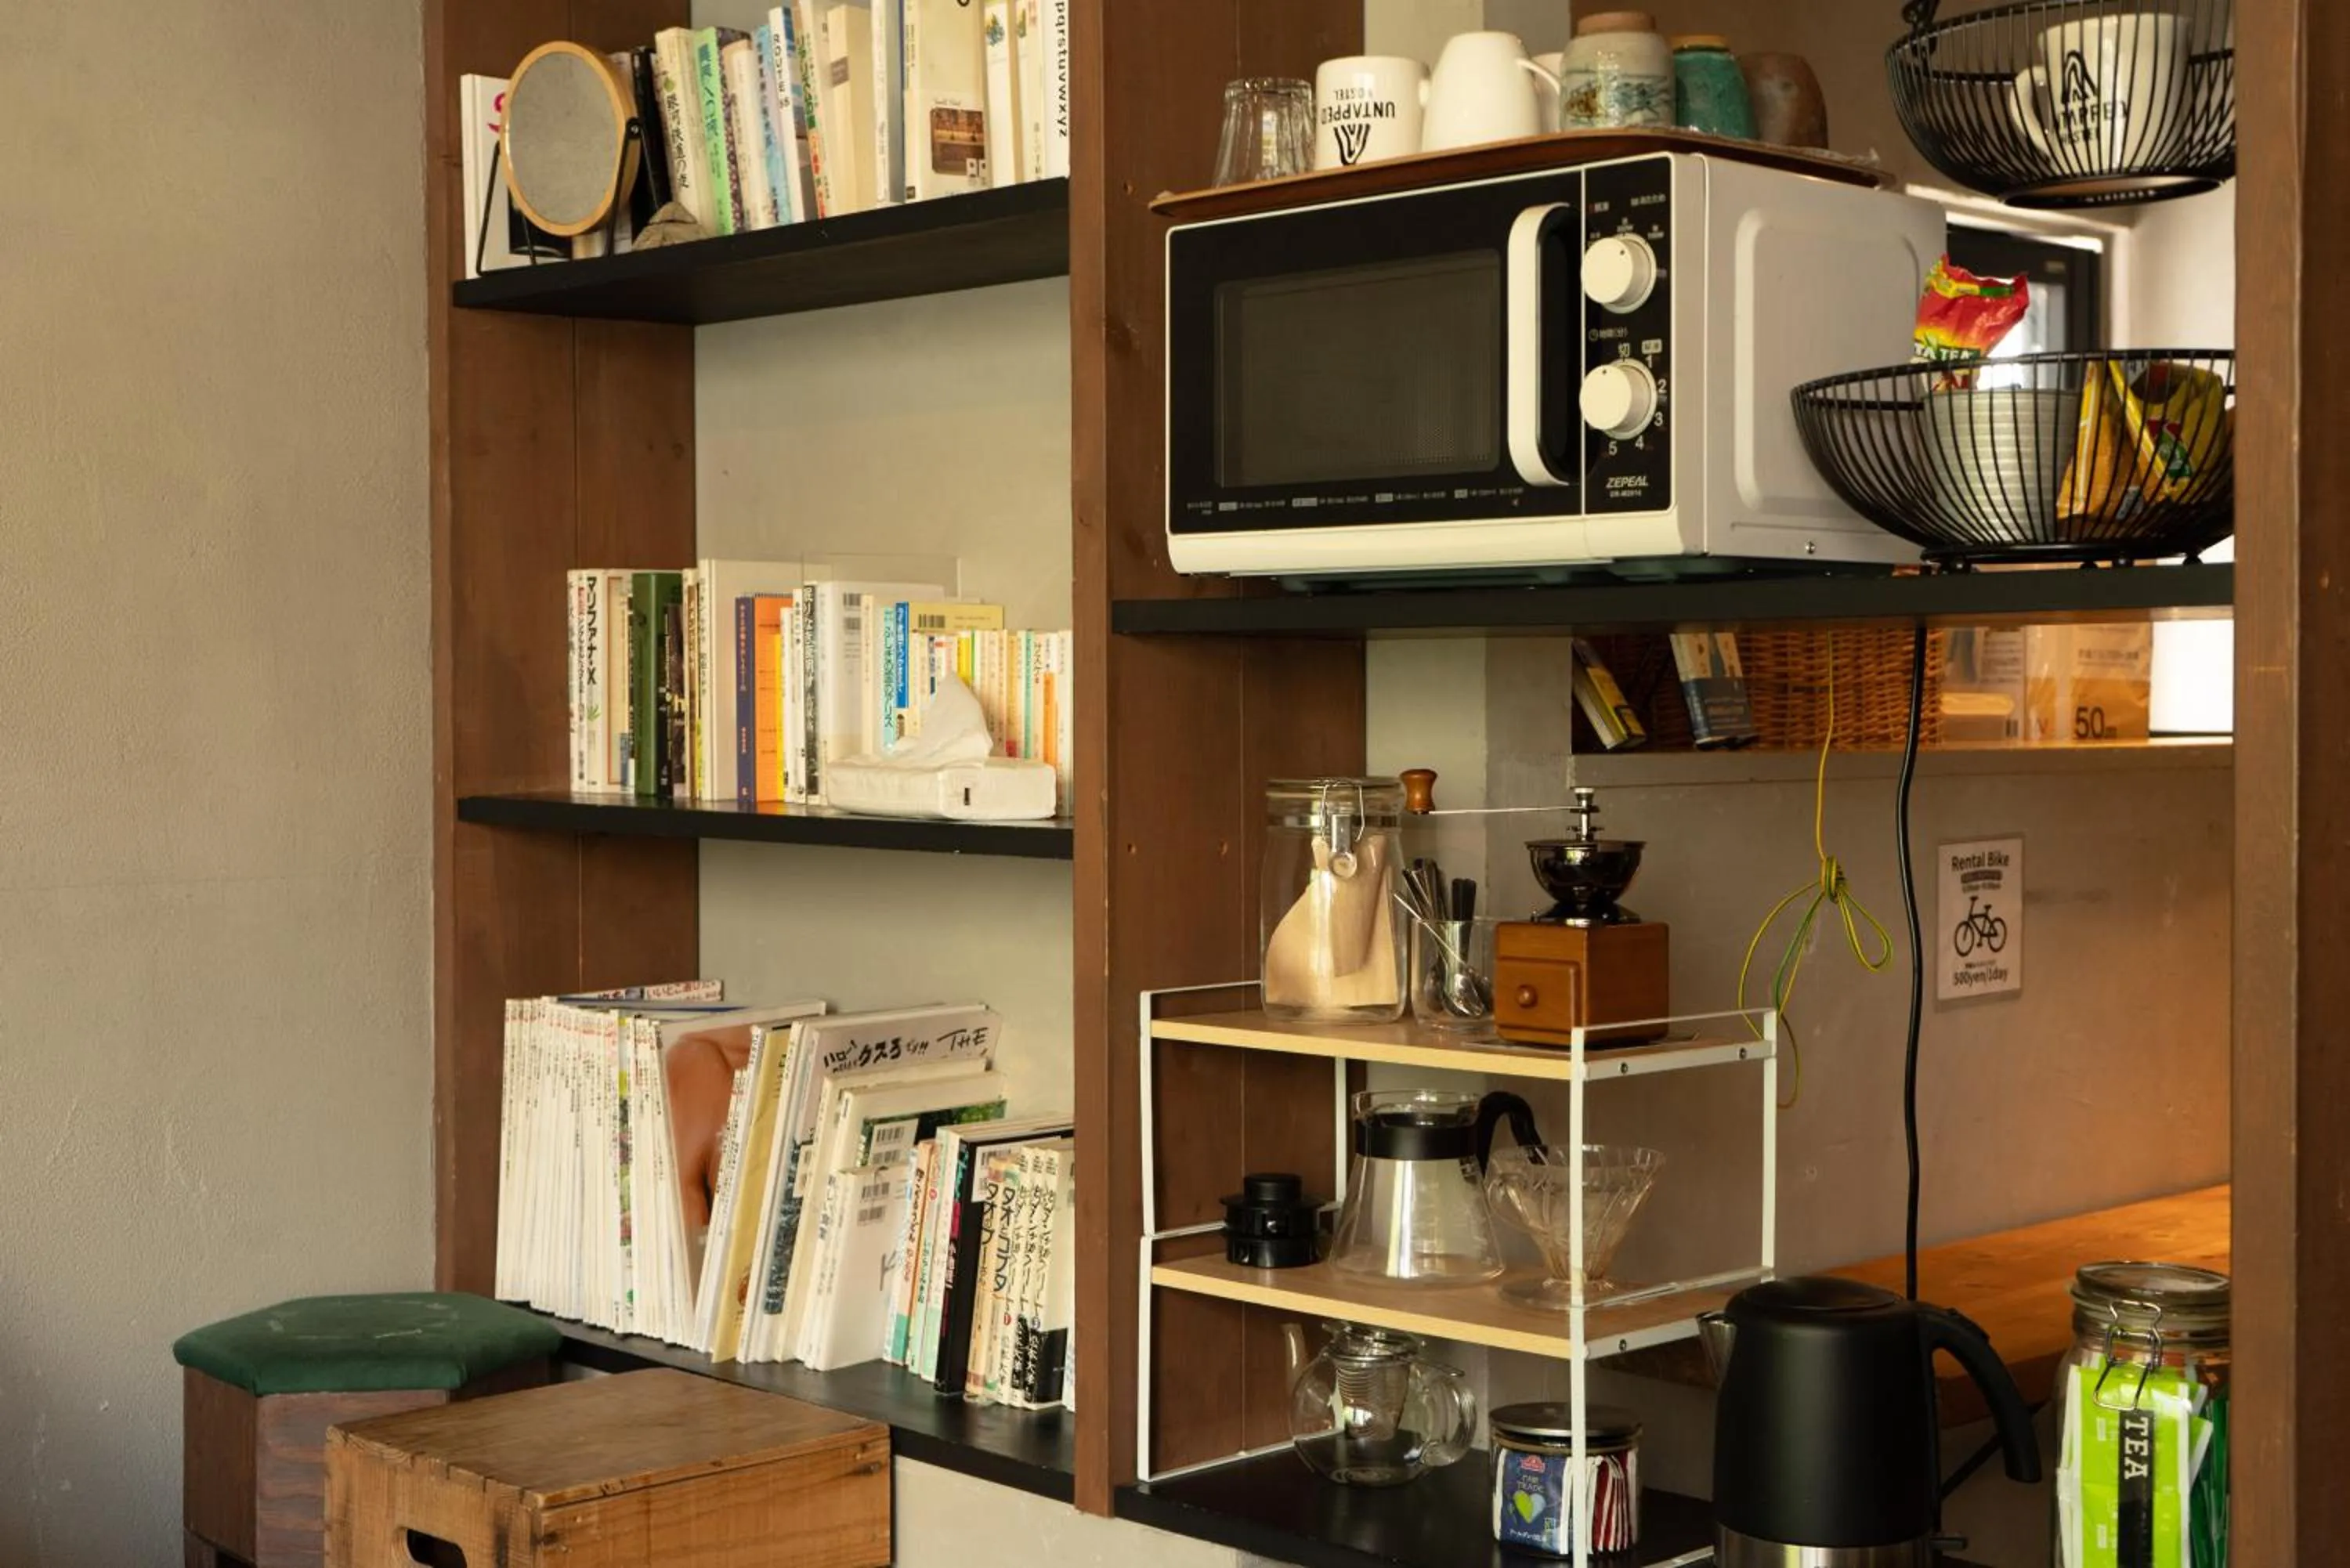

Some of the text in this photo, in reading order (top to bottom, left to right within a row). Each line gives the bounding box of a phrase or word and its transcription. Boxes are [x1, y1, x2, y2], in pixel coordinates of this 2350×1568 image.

[1321, 101, 1396, 125] UNTAPPED
[1647, 355, 1654, 368] 1
[1658, 379, 1667, 393] 2
[1654, 412, 1664, 426] 3
[1608, 441, 1618, 456] 5
[1635, 435, 1645, 450] 4
[1606, 475, 1649, 489] ZEPEAL
[1951, 851, 2009, 872] Rental Bike
[2124, 1417, 2149, 1480] TEA
